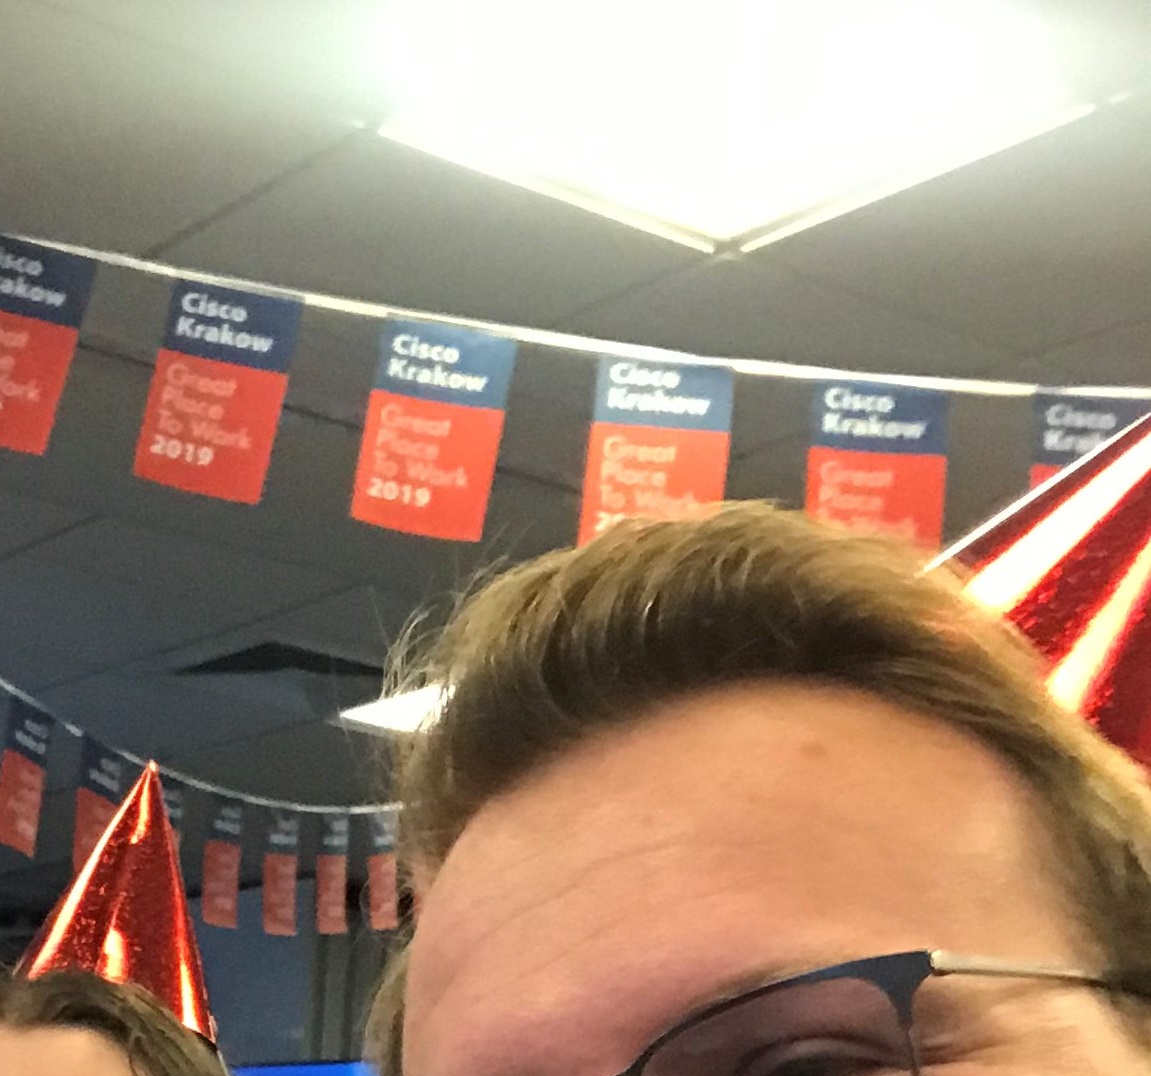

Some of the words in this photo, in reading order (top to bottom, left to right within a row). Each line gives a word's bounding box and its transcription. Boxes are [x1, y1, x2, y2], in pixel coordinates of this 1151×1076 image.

[181, 291, 248, 323] Cisco
[175, 315, 274, 354] Krakow
[392, 333, 461, 365] Cisco
[166, 363, 238, 398] Great
[386, 357, 489, 393] Krakow
[609, 362, 682, 390] Cisco
[161, 385, 225, 422] Place
[607, 386, 712, 417] Krakow
[824, 386, 897, 414] Cisco
[380, 404, 453, 437] Great
[822, 411, 929, 440] Krakow
[1045, 403, 1117, 430] Cisco
[191, 417, 253, 449] Work
[375, 428, 440, 462] Place
[150, 434, 215, 467] 2019
[603, 435, 677, 465] Great
[405, 458, 468, 489] Work
[600, 459, 668, 488] Place
[366, 476, 432, 508] 2019
